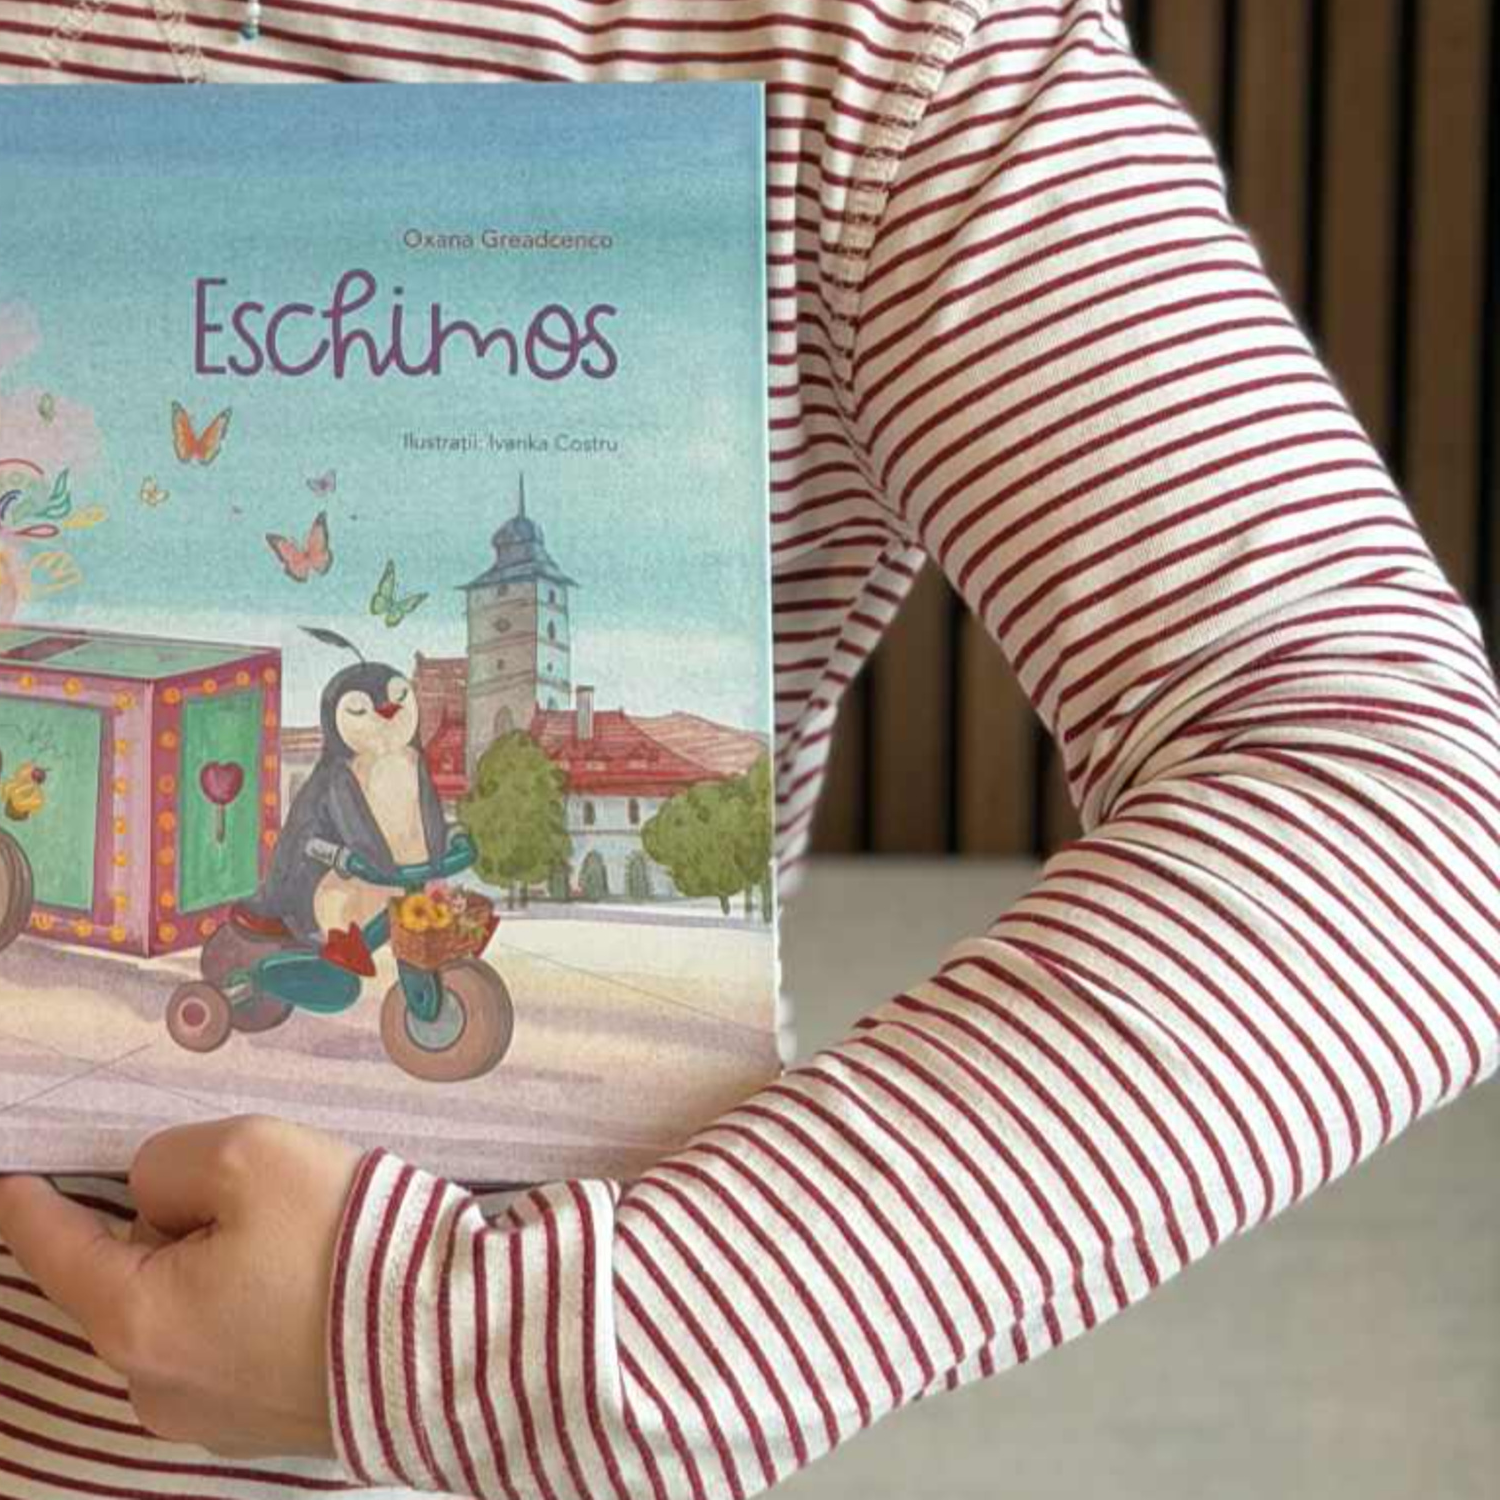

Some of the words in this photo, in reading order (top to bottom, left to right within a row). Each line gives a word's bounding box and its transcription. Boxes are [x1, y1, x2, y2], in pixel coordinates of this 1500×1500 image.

[403, 228, 474, 248] Oxana
[481, 229, 613, 249] Greadcenco
[194, 268, 618, 381] Eschimos
[488, 433, 548, 451] Ivanka
[553, 433, 618, 451] Costru
